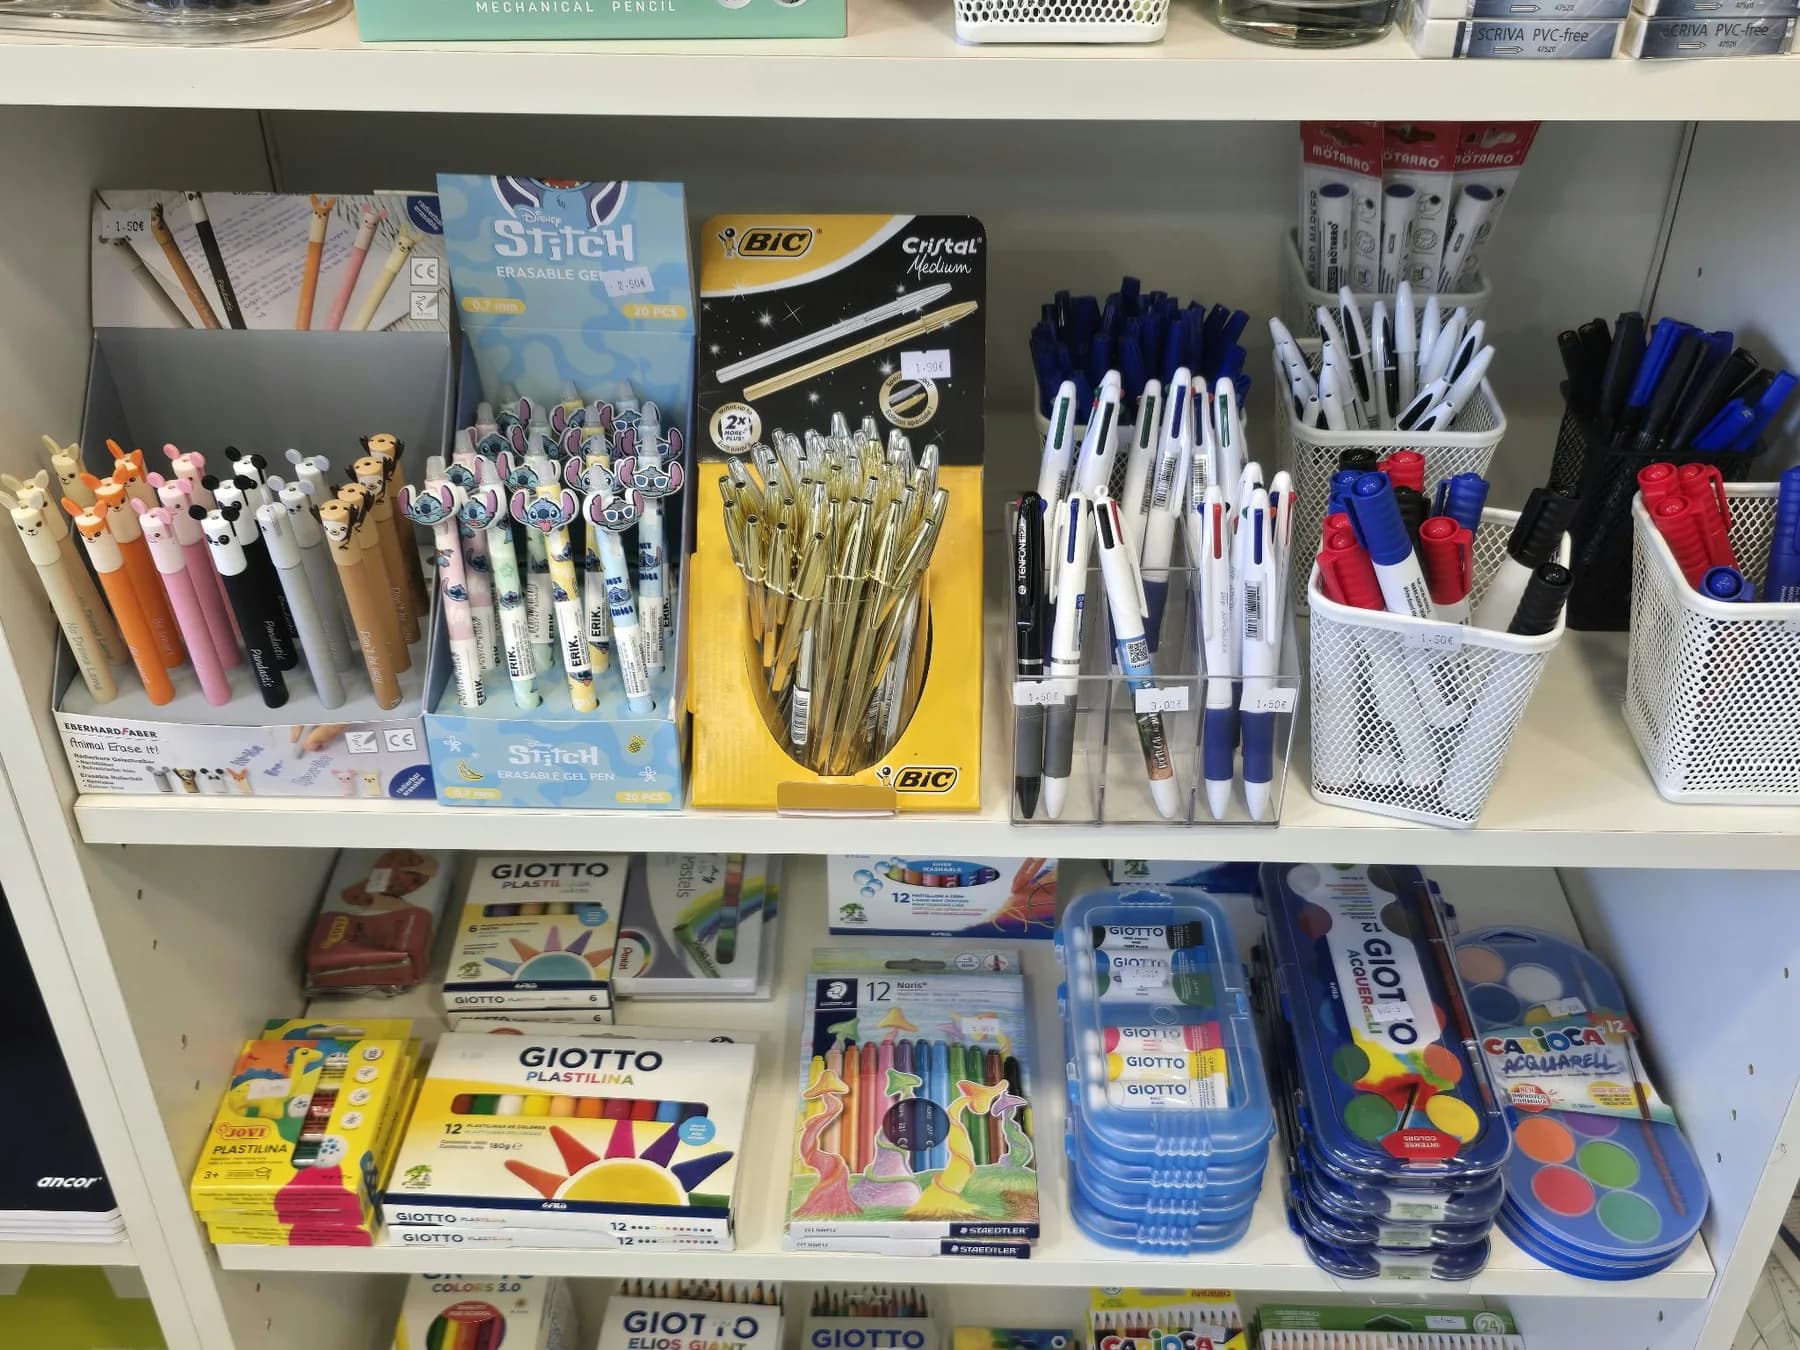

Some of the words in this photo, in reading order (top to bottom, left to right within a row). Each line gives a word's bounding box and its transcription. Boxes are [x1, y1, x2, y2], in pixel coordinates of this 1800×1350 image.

[476, 1, 594, 14] MECHANICAL
[611, 0, 676, 13] PENCIL
[1477, 27, 1524, 41] SCRIVA
[1532, 27, 1589, 42] PVC-free
[1714, 23, 1769, 37] PVC-free
[521, 209, 561, 228] Disney
[496, 265, 575, 281] ERASABLE
[578, 268, 602, 281] GE
[906, 254, 973, 282] Medium
[472, 299, 494, 312] 0.7
[495, 302, 518, 312] mm
[652, 304, 679, 318] PCS
[1018, 543, 1027, 581] TENFON
[250, 647, 273, 689] Pandastic
[69, 736, 105, 751] Animal
[107, 741, 143, 754] Erase
[497, 769, 560, 782] ERASABLE
[563, 771, 586, 782] GEL
[590, 771, 615, 782] PEN
[490, 862, 609, 879] GIOTTO
[892, 892, 910, 904] 12
[1109, 926, 1164, 937] GIOTTO
[866, 981, 891, 1001] 12
[896, 981, 923, 990] Noris
[1363, 938, 1418, 1045] GIOTO
[454, 995, 505, 1005] GIOTTO
[519, 1046, 664, 1072] GIOTTO
[1126, 1055, 1185, 1069] GIOTTO
[526, 1070, 635, 1086] PLASTILINA
[1127, 1084, 1188, 1095] GIOTTO
[445, 1123, 463, 1135] 12
[212, 1144, 288, 1156] PLASTILINA
[37, 1176, 98, 1189] ancor
[396, 1212, 457, 1223] GIOTTO
[611, 1222, 628, 1232] 12
[968, 1225, 1026, 1235] STAEDTLER
[403, 1233, 464, 1243] GIOTTO
[617, 1237, 634, 1246] 12
[959, 1245, 1017, 1255] STAEDTLER
[432, 1283, 494, 1293] COLORS
[628, 1337, 681, 1350] ELIOS
[811, 1328, 925, 1349] GIOTTO
